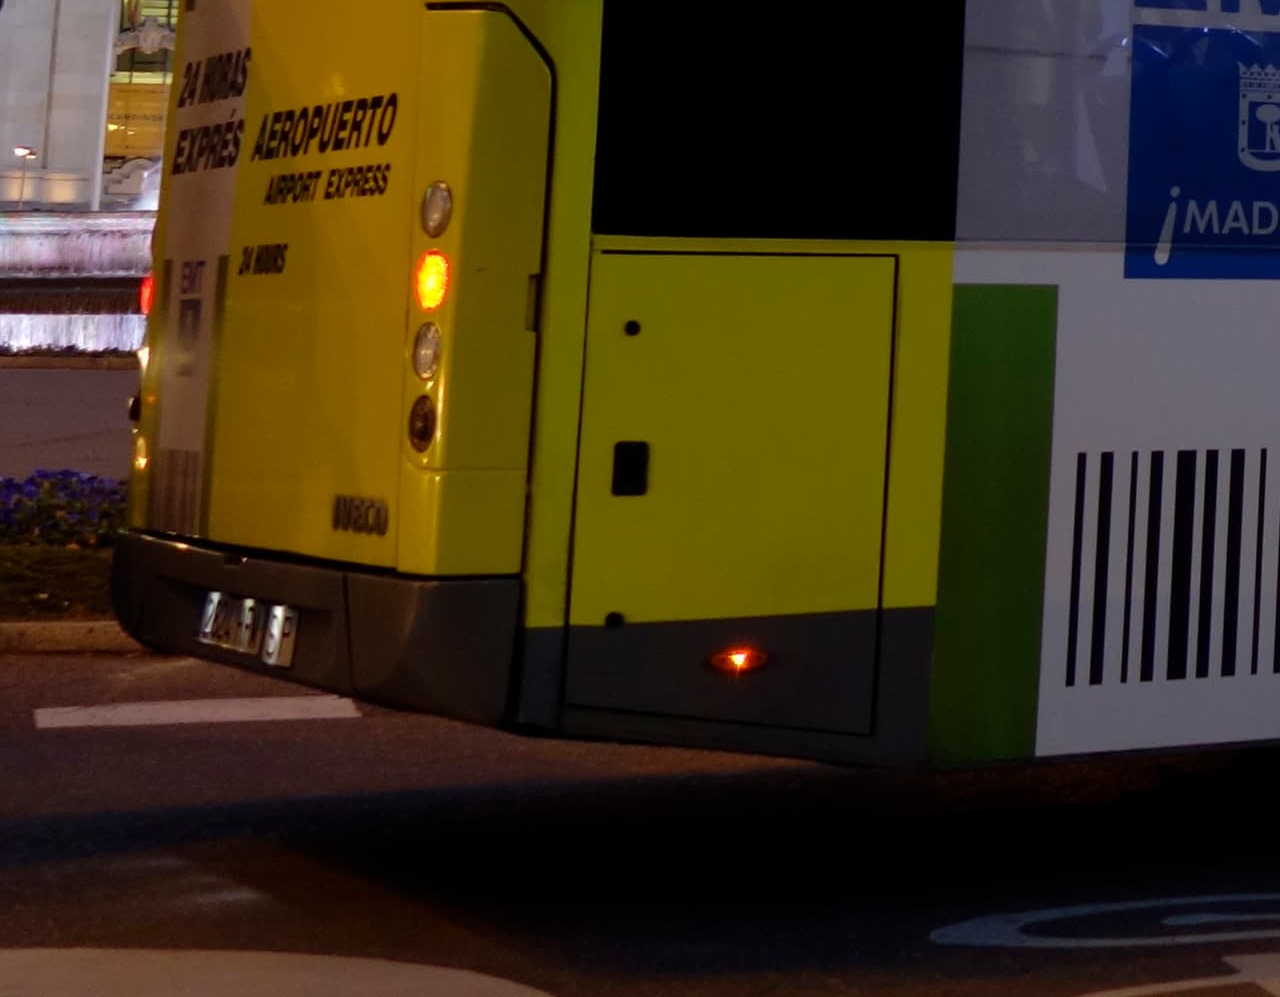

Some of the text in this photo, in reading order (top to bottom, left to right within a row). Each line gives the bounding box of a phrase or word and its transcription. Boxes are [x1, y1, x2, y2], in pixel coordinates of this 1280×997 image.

[177, 47, 252, 109] 24 HORAS
[171, 92, 398, 176] EXPRÉS AEROPUERTO
[263, 163, 392, 206] AIRPORT EXPRESS
[238, 243, 289, 276] 24 HOURS
[333, 495, 389, 537] IVECO
